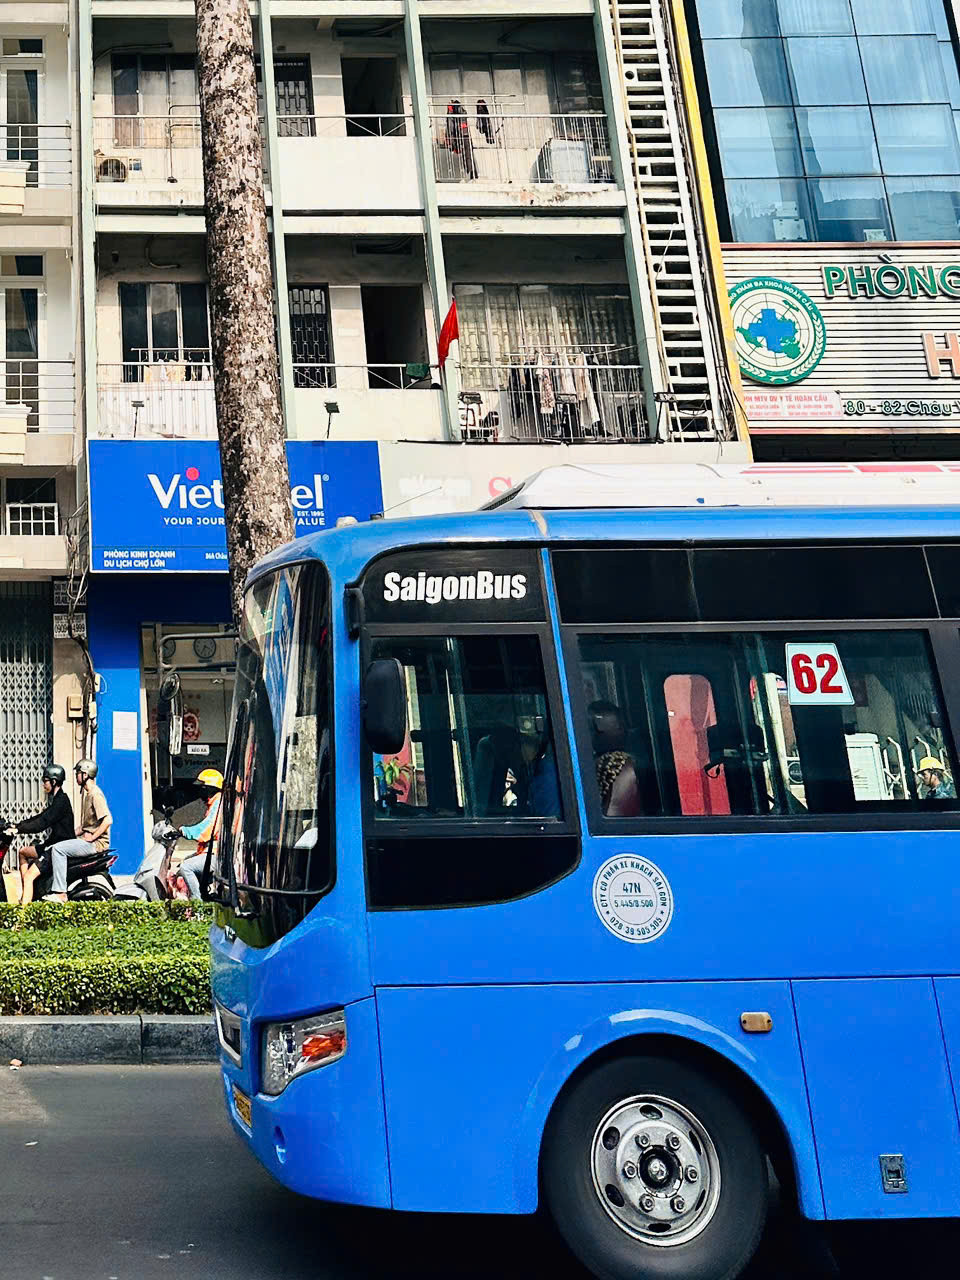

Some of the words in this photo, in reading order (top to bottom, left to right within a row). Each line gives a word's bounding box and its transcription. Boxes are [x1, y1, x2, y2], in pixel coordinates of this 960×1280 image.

[822, 253, 960, 297] PHÒNG
[846, 400, 866, 415] 80
[883, 400, 903, 415] 82
[906, 399, 953, 415] Châu
[147, 467, 324, 509] Vietel
[164, 517, 193, 526] YOUR
[196, 517, 226, 526] JOUR
[103, 549, 129, 558] PHÒNG
[130, 550, 148, 558] KINH
[149, 550, 175, 559] DOANH
[104, 559, 115, 567] DU
[383, 570, 527, 604] SaigonBus
[791, 653, 843, 694] 62
[620, 860, 628, 869] XE
[622, 882, 642, 894] 47N
[609, 916, 624, 930] 028
[625, 926, 635, 935] 39
[637, 925, 651, 936] 505
[650, 916, 663, 930] 505
